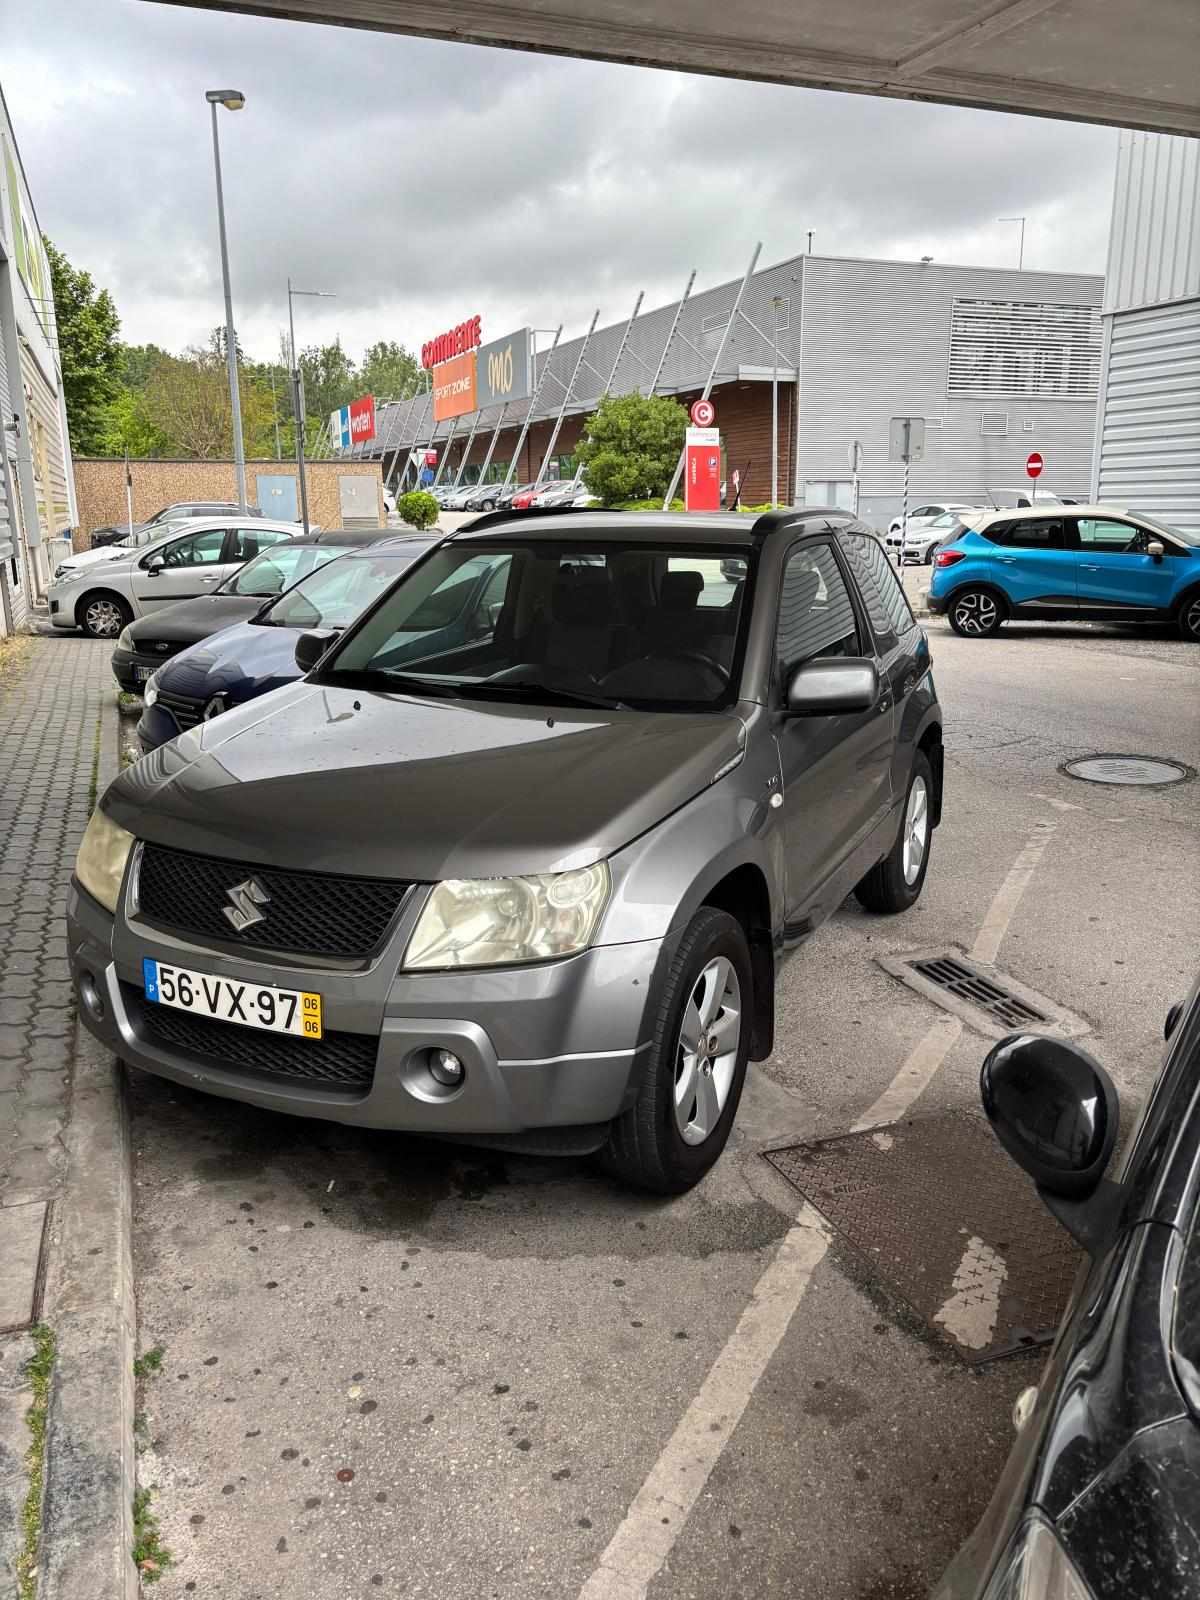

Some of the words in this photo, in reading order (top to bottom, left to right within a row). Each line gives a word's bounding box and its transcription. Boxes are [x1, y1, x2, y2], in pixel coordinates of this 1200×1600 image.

[352, 409, 370, 432] worten
[303, 997, 318, 1010] 06
[304, 1021, 319, 1034] 06
